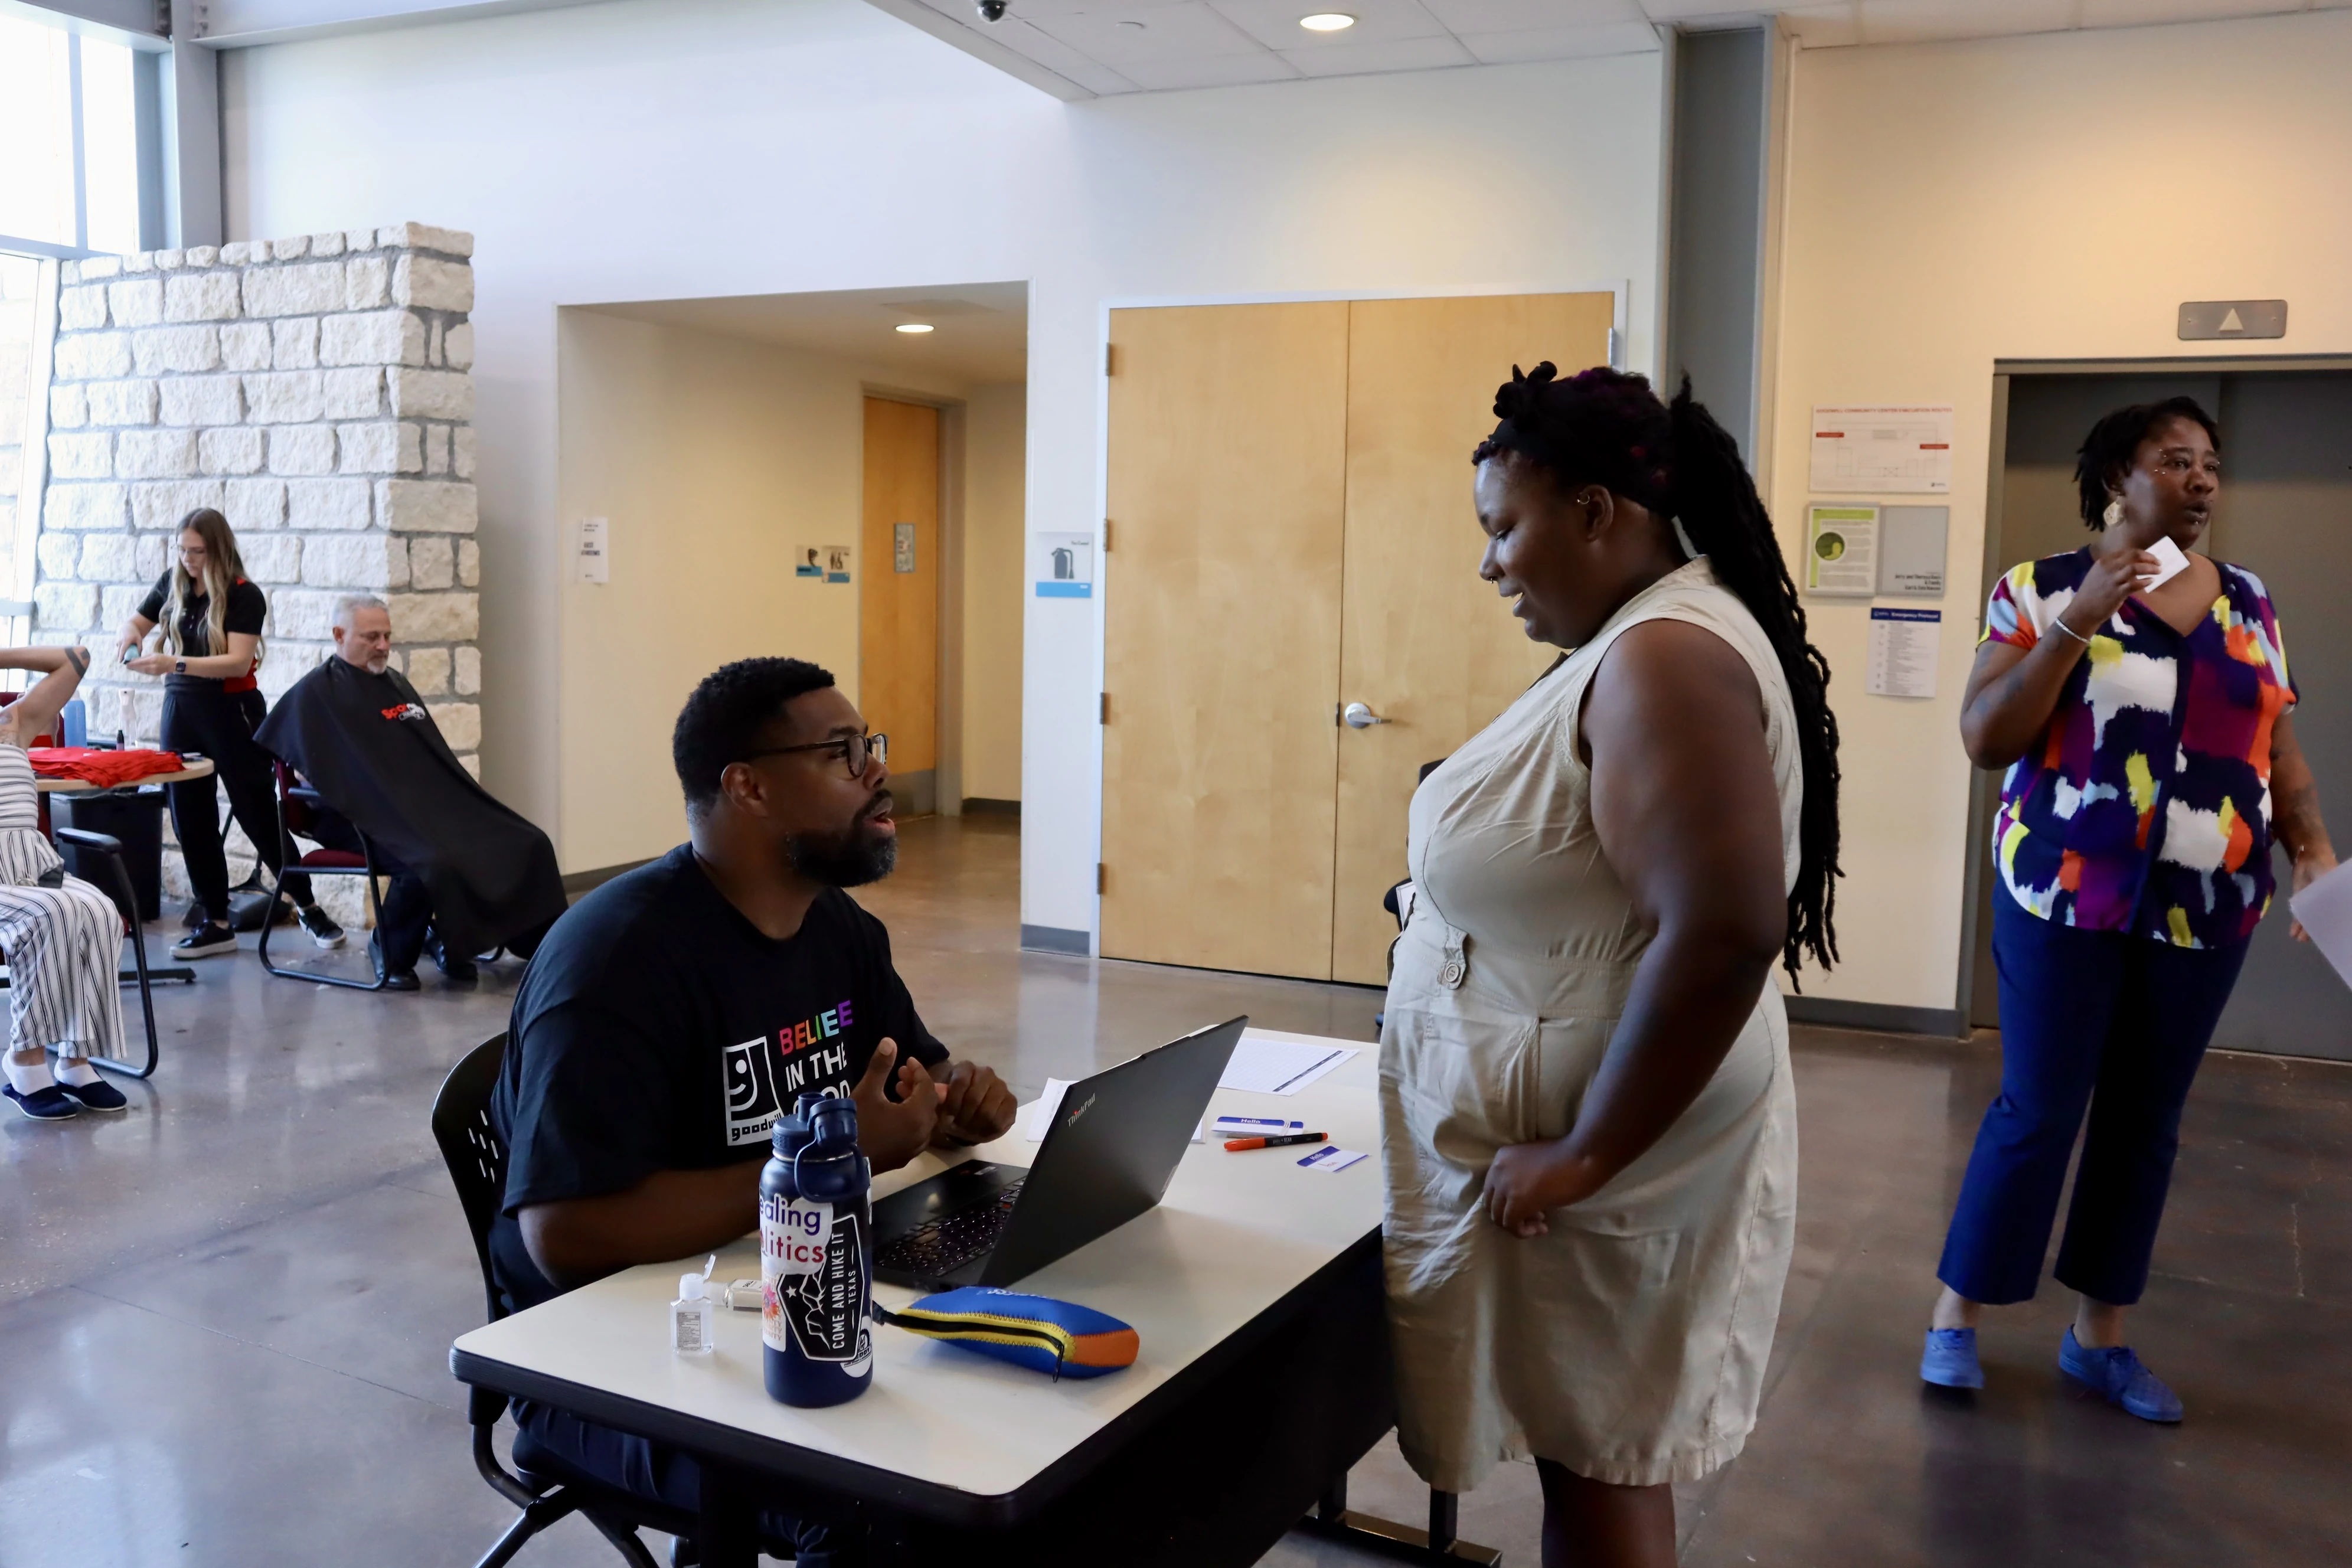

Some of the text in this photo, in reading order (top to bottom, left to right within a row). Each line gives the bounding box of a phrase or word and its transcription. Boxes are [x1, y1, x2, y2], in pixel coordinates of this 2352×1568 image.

[785, 1041, 847, 1092] IN THE
[1067, 1092, 1095, 1127] ThinkPad
[759, 1196, 821, 1236] ealing
[832, 1233, 845, 1349] COME AND HIKE IT
